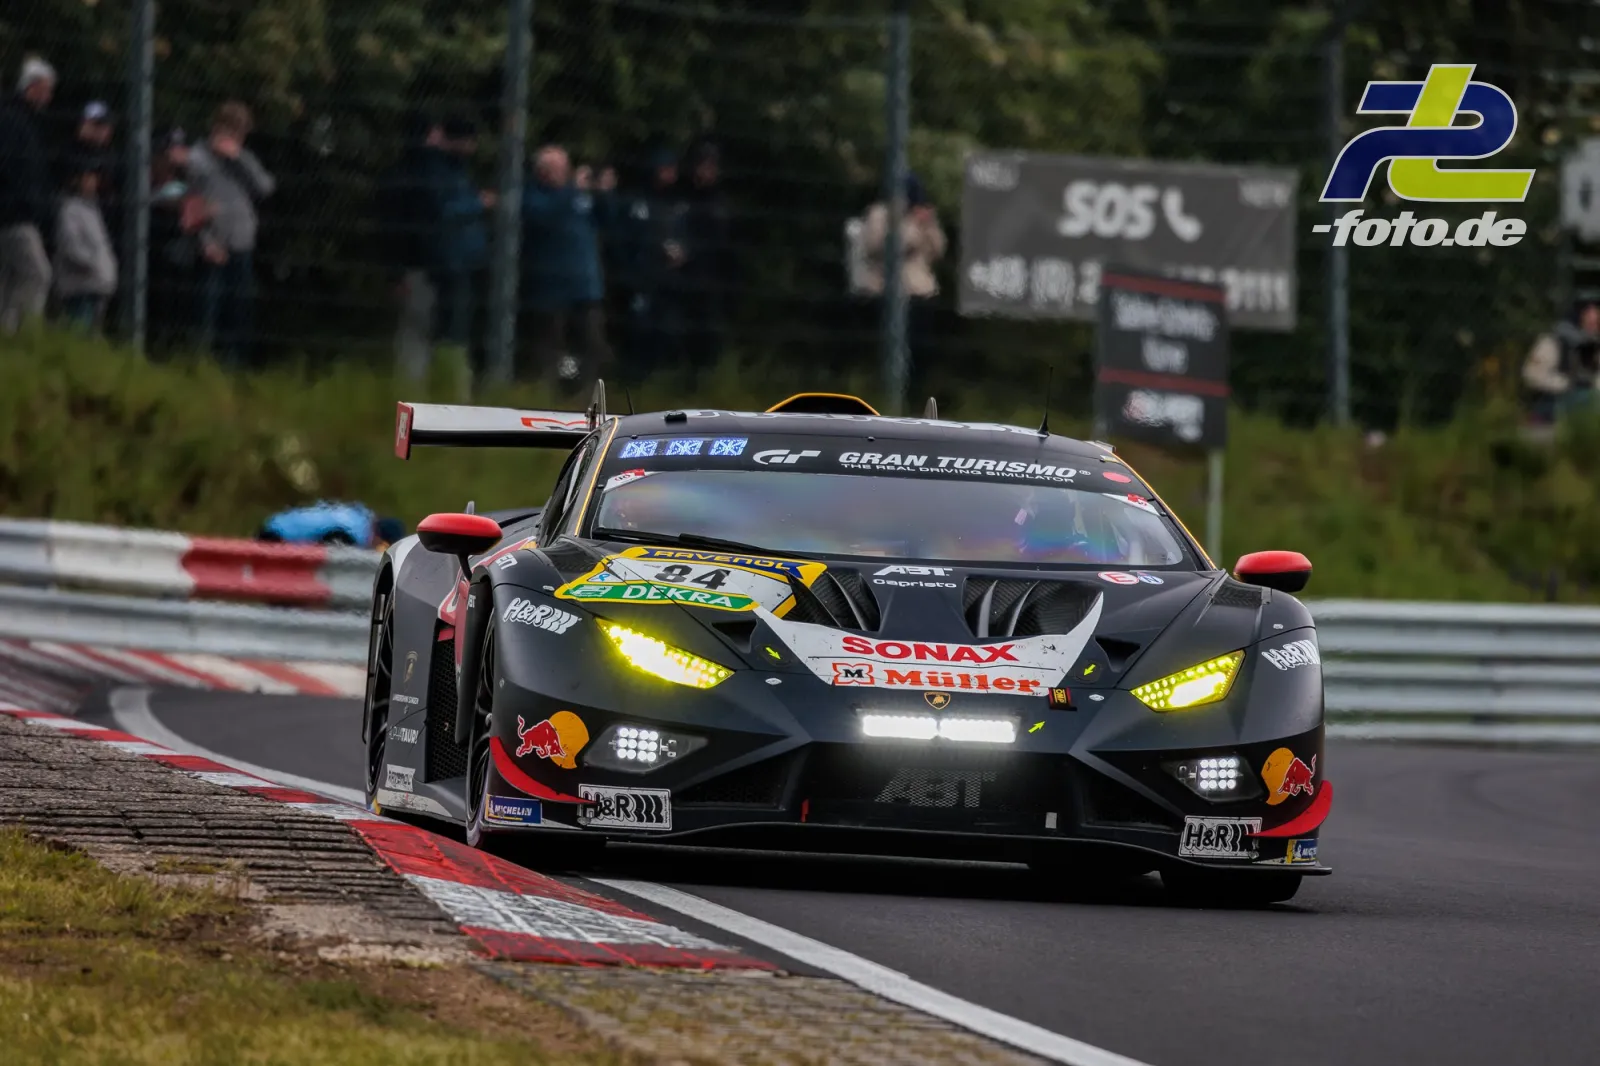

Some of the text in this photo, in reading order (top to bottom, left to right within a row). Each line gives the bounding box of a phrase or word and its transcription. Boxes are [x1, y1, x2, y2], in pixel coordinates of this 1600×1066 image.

[1058, 181, 1159, 239] SOS
[838, 452, 928, 467] GRAN
[919, 467, 982, 475] DRIVING
[986, 471, 1074, 483] SIMULATOR
[653, 549, 791, 571] RAVENOL
[873, 565, 953, 576] ABT
[654, 564, 731, 590] 84
[873, 579, 957, 588] Capristo
[622, 584, 732, 608] DEKRA
[842, 636, 1020, 663] SONAX
[884, 669, 1041, 693] Müller
[494, 804, 532, 816] MICHELIN
[1185, 823, 1230, 849] H&R
